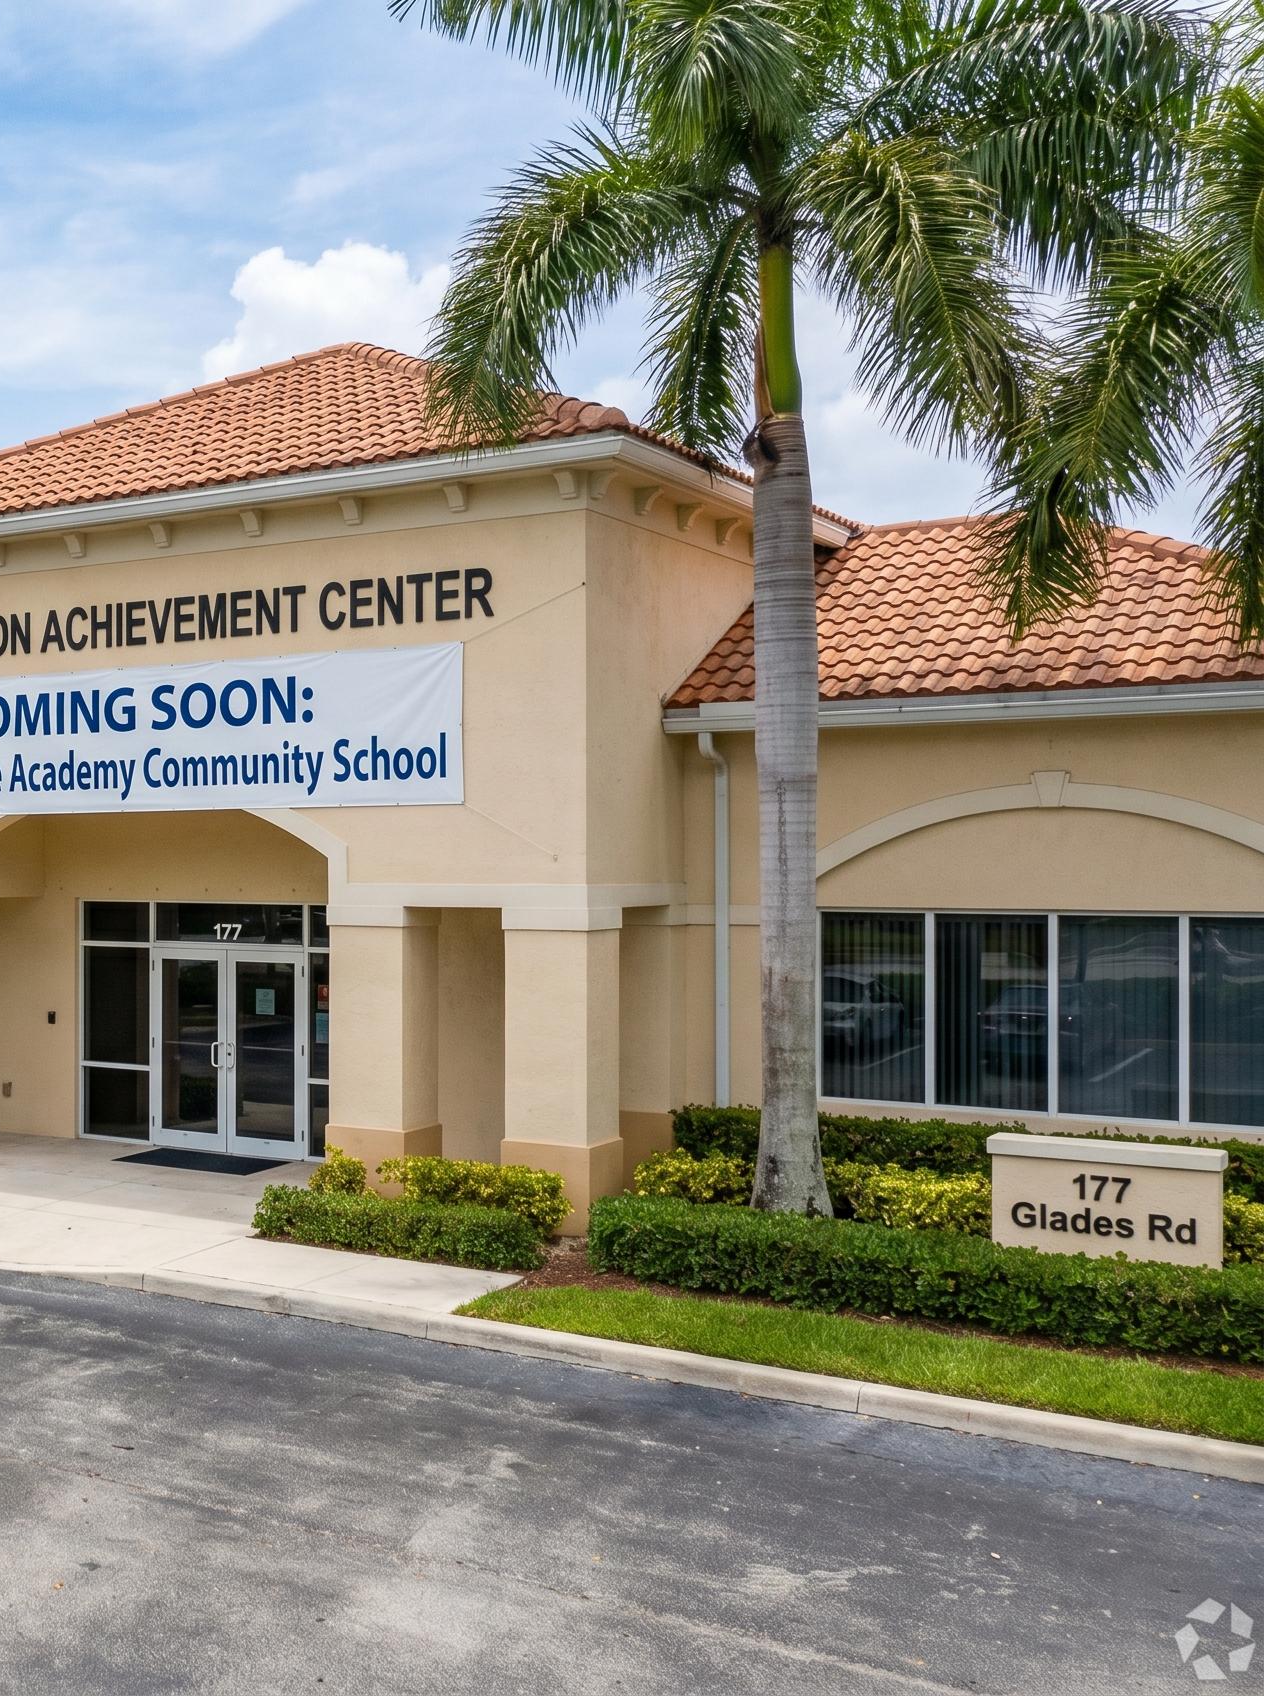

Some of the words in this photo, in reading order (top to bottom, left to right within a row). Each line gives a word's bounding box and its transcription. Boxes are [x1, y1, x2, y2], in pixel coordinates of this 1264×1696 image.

[39, 584, 307, 654] ACHIEVEMENT
[318, 567, 495, 631] CENTER
[151, 676, 314, 731] SOON:
[9, 749, 136, 801] Academy
[143, 742, 324, 797] Community
[333, 732, 447, 783] School
[213, 923, 242, 941] 177
[1072, 1173, 1132, 1204] 177
[1010, 1201, 1135, 1239] Glades
[1147, 1213, 1197, 1246] Rd
